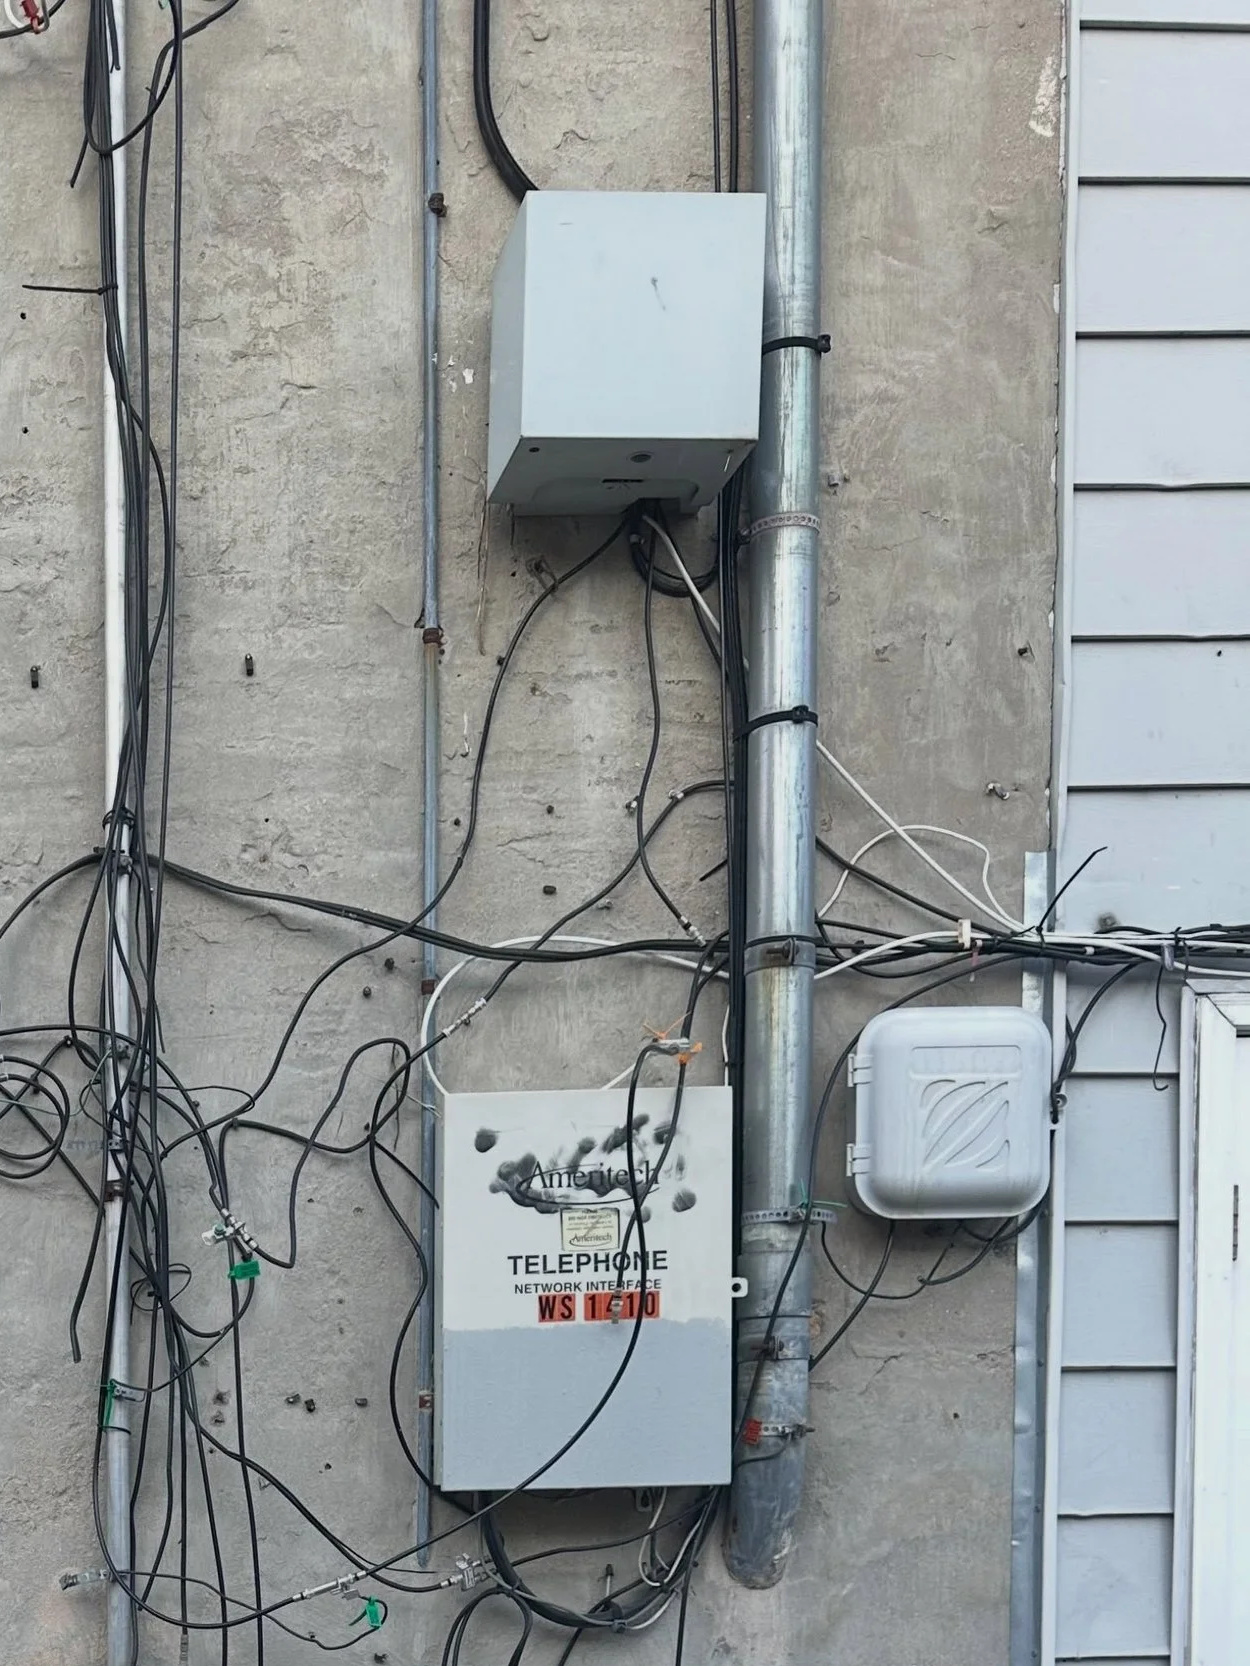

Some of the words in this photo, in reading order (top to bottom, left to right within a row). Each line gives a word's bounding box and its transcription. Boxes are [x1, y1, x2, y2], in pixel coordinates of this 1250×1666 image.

[526, 1160, 659, 1190] Ameritech
[507, 1250, 668, 1276] TELEPHONE
[514, 1281, 582, 1295] NETWORK
[586, 1278, 662, 1292] INTERFACE
[538, 1293, 573, 1320] WS
